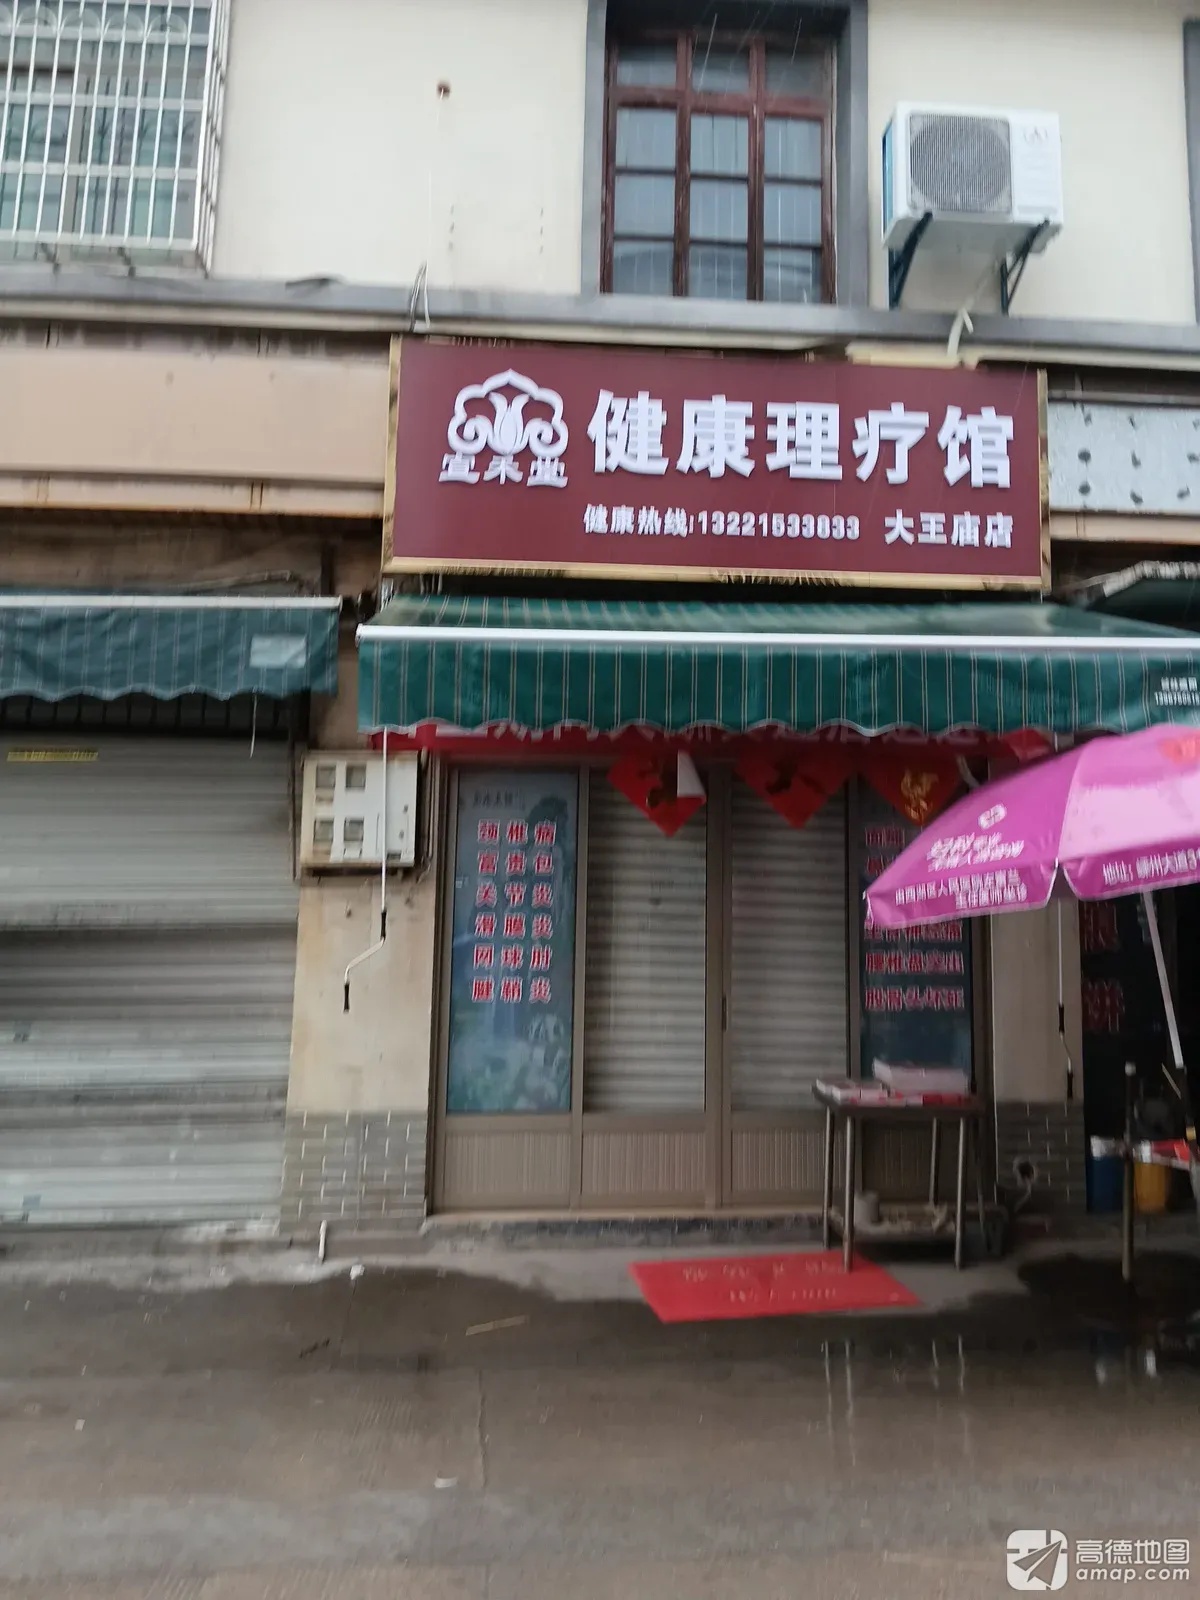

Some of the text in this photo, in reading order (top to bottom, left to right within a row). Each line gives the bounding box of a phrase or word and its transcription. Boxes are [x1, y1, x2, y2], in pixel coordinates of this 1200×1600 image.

[587, 389, 1014, 489] 健康理疗馆
[884, 510, 1014, 549] 大王庙店
[477, 819, 556, 846] 颈椎病
[477, 850, 554, 877] 富贵包
[475, 881, 553, 908] 关节炎
[473, 942, 551, 971] 网球肘
